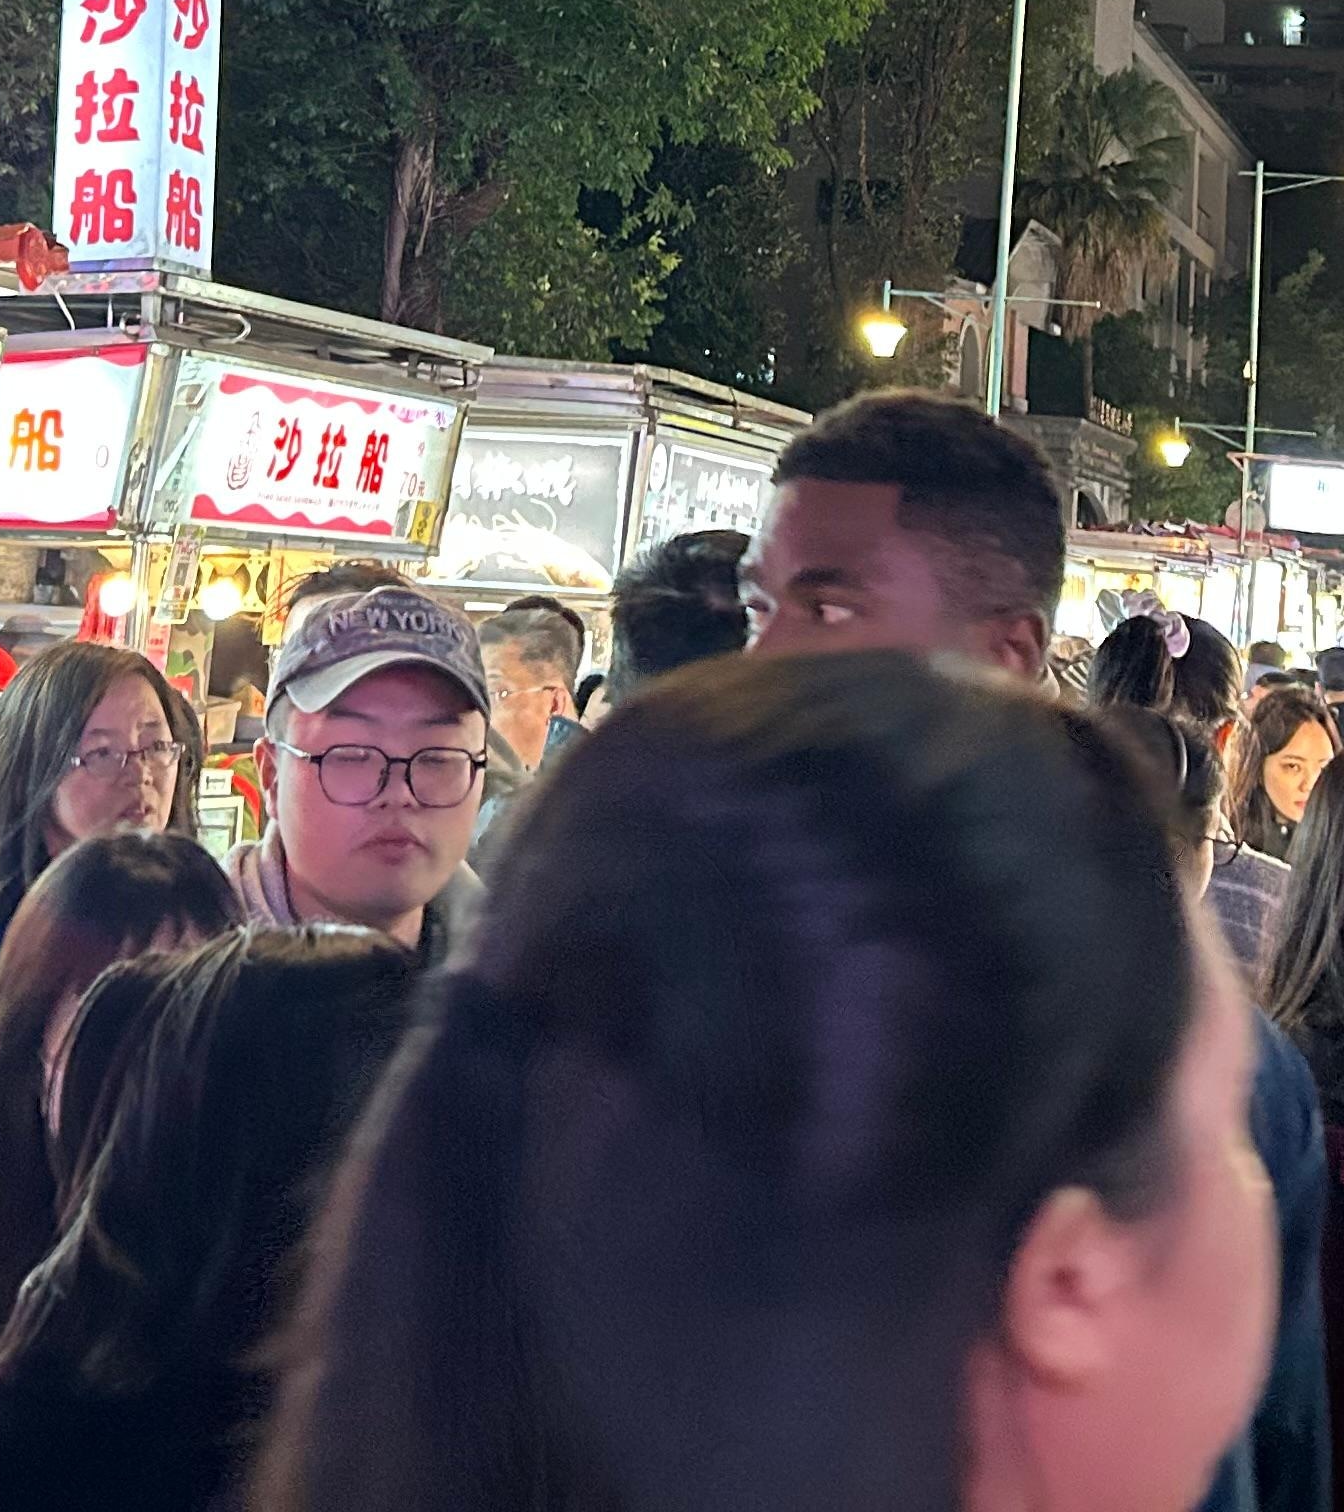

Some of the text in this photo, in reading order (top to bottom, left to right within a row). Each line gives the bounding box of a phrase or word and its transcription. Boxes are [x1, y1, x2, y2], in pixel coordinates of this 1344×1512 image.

[266, 417, 390, 496] 沙拉船
[328, 607, 462, 641] NEW YORK
